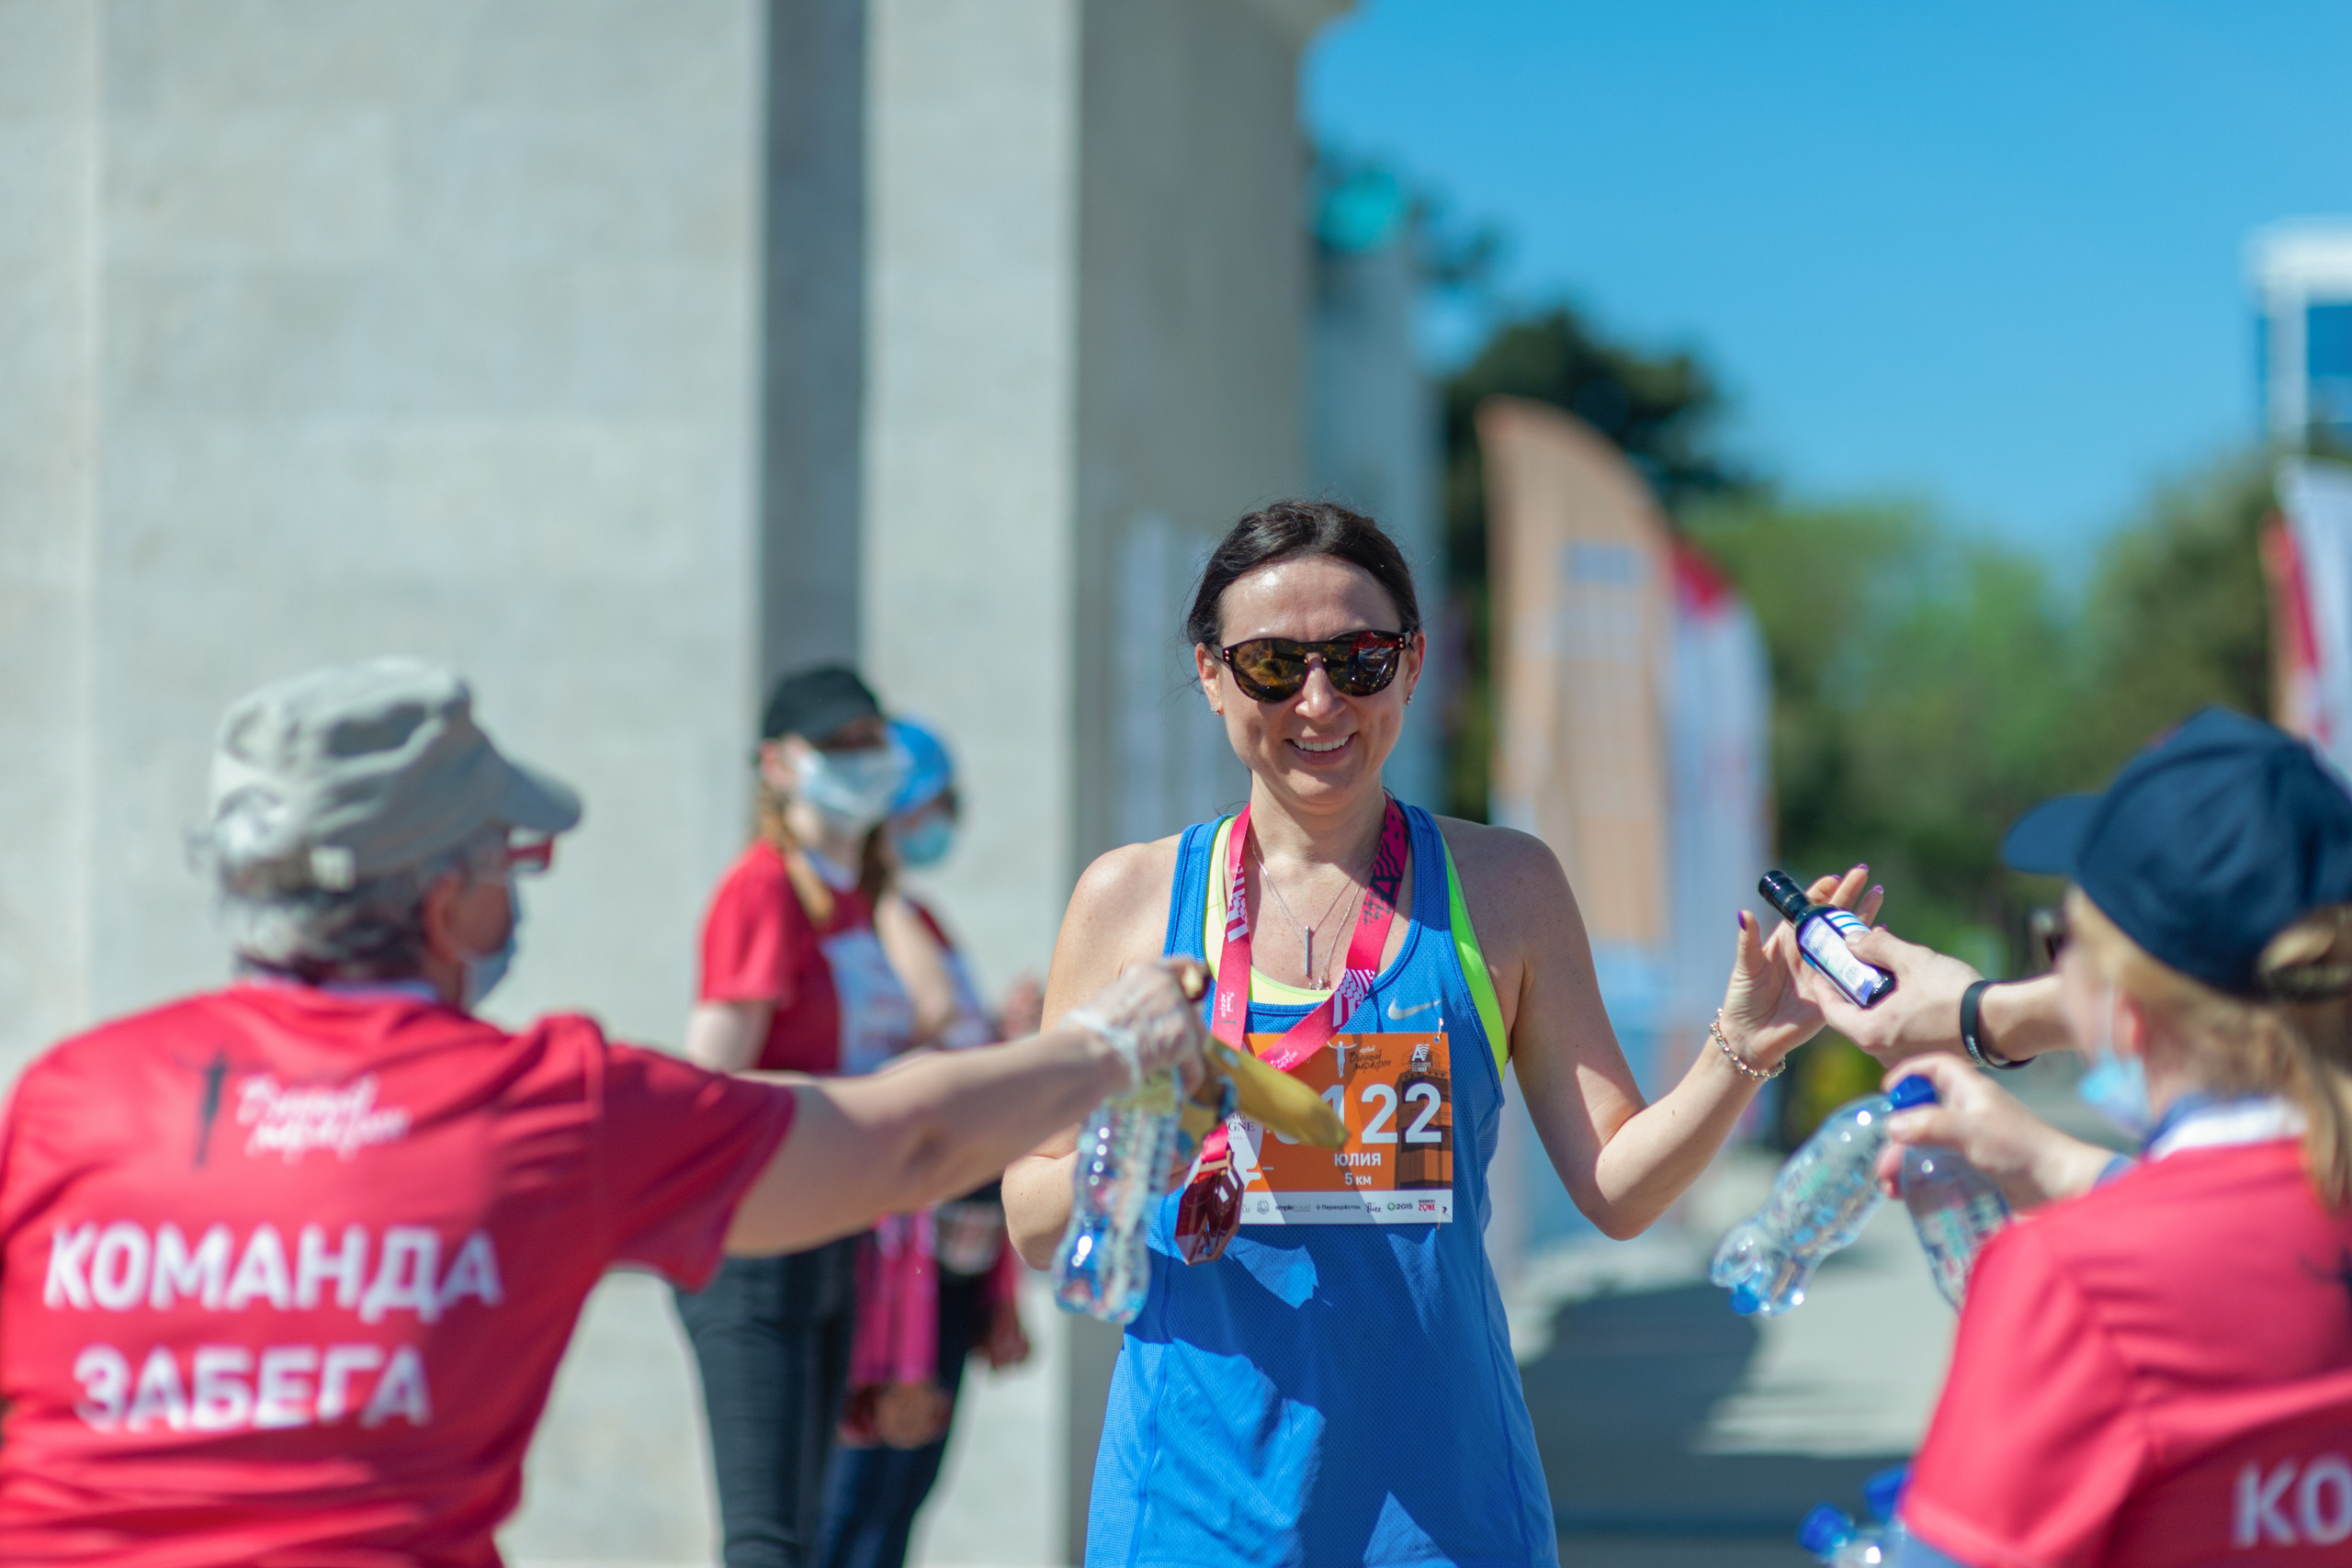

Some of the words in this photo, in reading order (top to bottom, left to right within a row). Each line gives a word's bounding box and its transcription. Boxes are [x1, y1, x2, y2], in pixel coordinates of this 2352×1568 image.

[1334, 1152, 1382, 1167] ЮЛИЯ
[1344, 1172, 1353, 1186] 5
[1355, 1175, 1372, 1186] км
[43, 1219, 503, 1325] КОМАНДА
[72, 1344, 431, 1435] ЗАБЕГА
